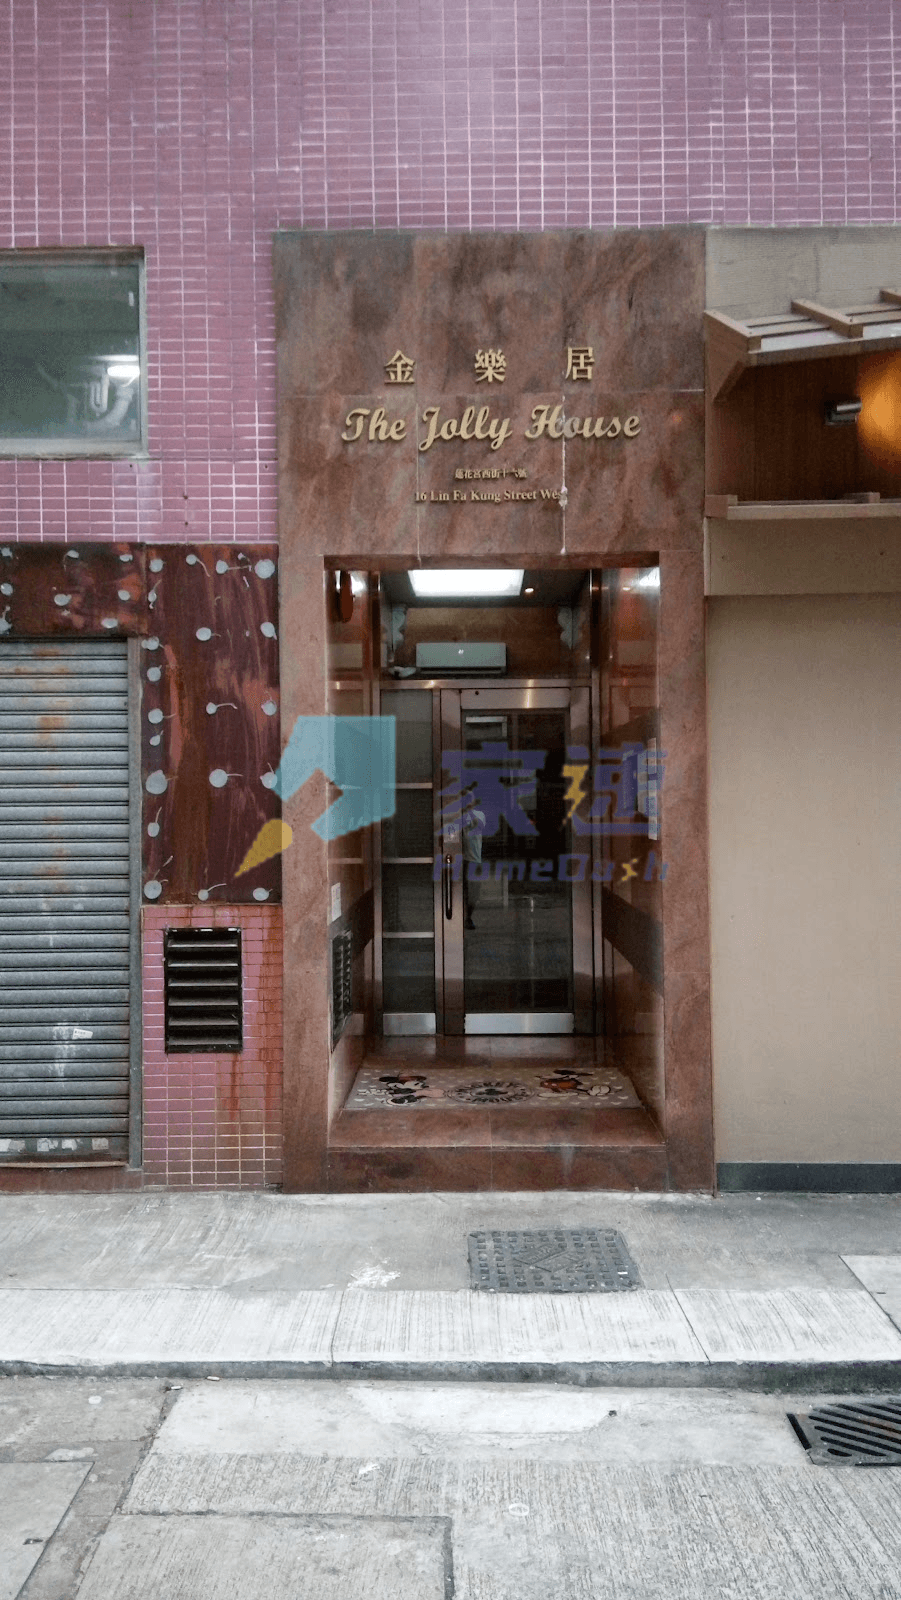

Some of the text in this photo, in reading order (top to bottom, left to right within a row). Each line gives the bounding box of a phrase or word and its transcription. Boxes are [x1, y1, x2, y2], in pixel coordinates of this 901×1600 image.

[384, 346, 595, 385] 金樂居
[341, 404, 641, 452] The Jolly House
[415, 490, 427, 502] 16
[430, 490, 450, 502] Lin
[453, 490, 467, 501] Fa
[471, 490, 502, 503] Kung
[503, 489, 537, 501] Street
